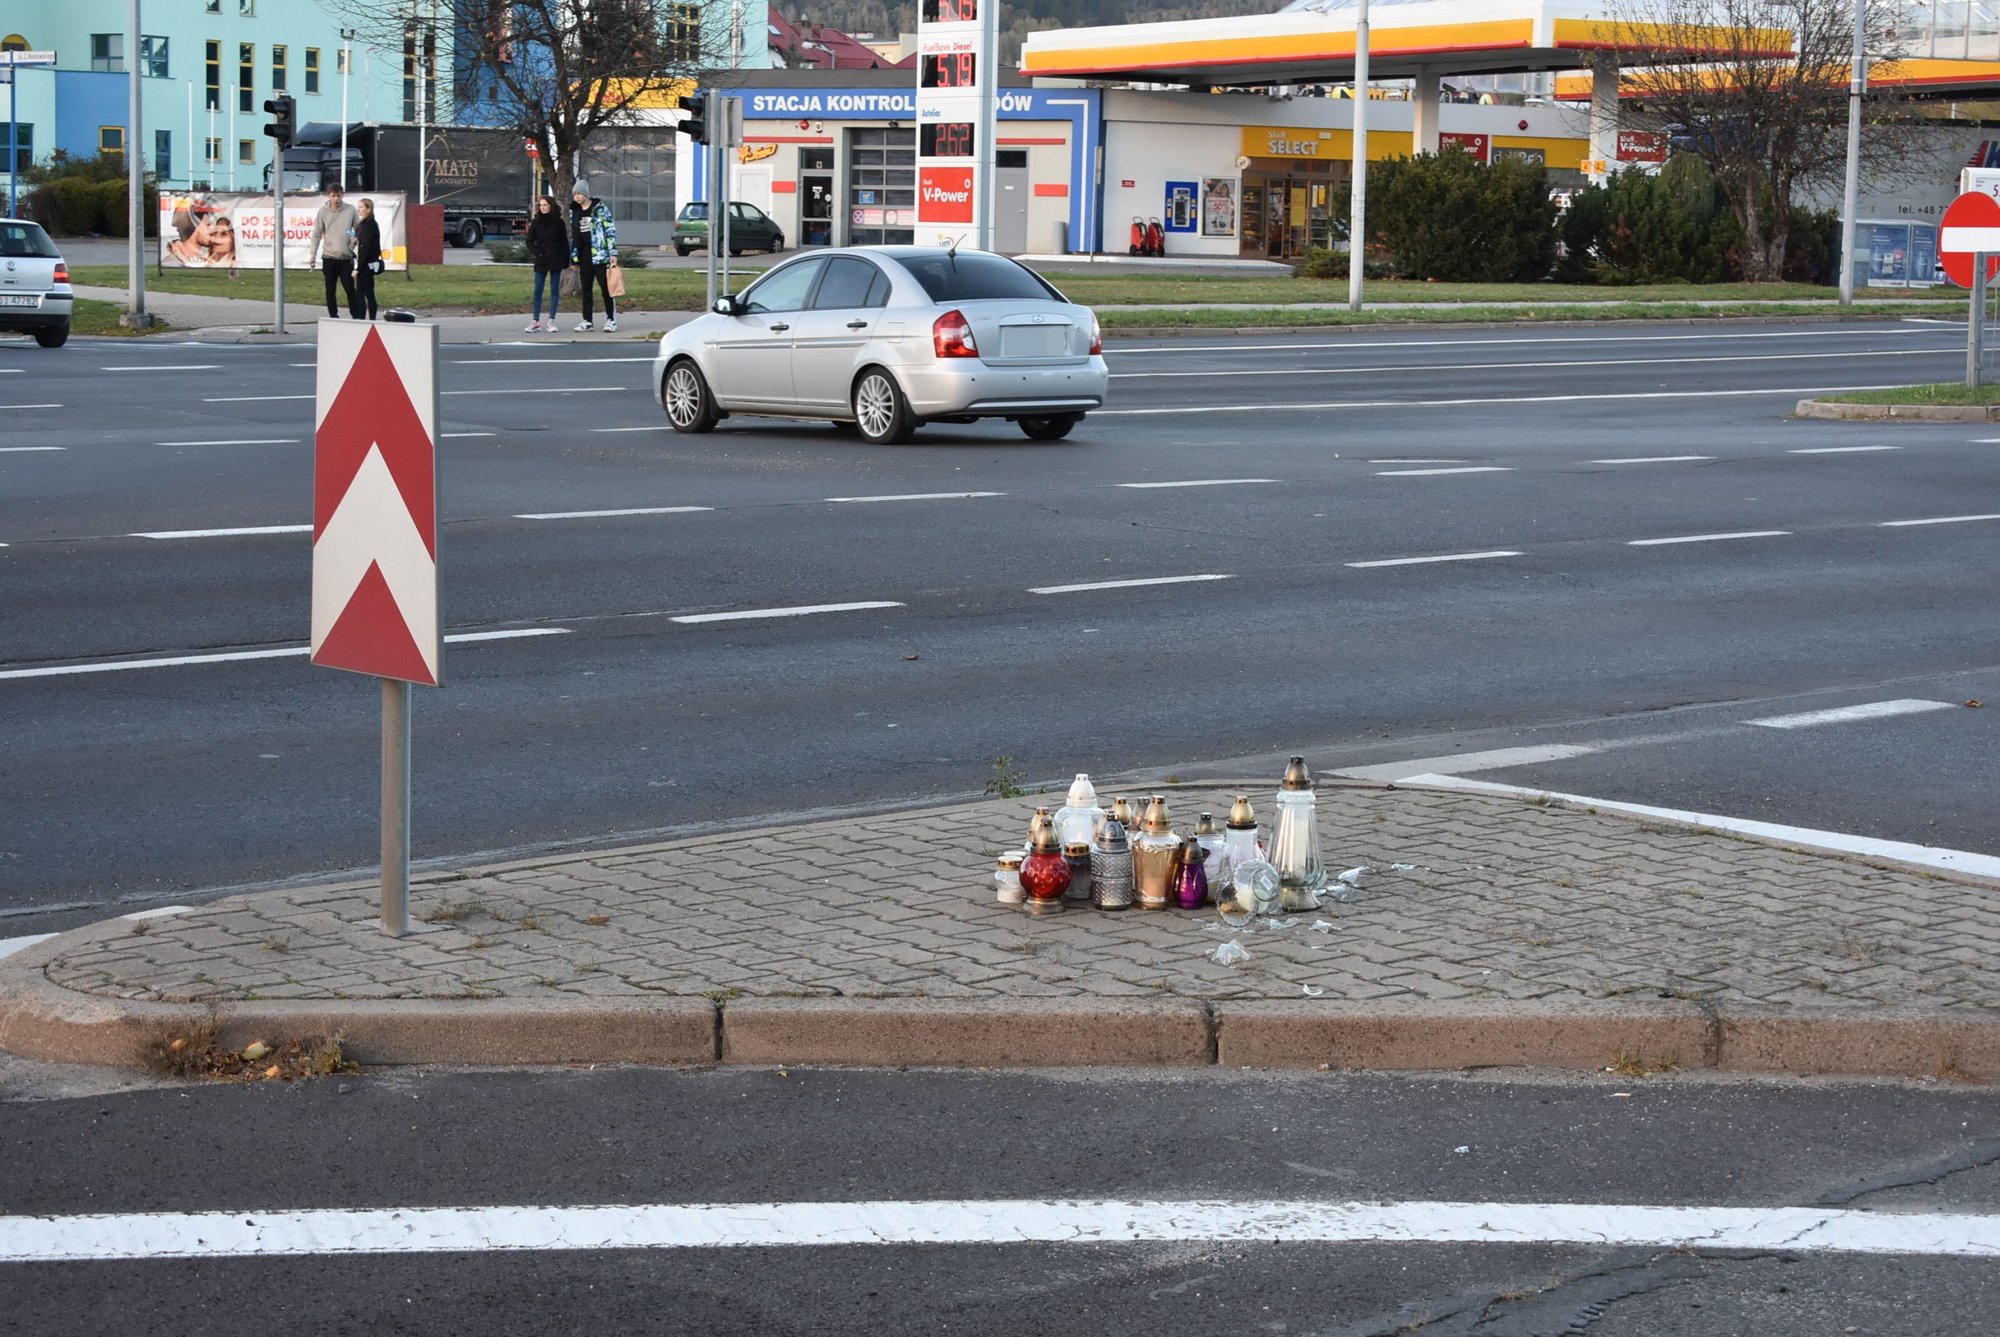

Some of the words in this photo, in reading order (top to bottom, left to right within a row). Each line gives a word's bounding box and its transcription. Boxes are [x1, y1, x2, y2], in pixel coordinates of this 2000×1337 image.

[953, 41, 973, 51] Diesel
[753, 95, 822, 111] STACJA
[827, 95, 916, 111] KONTROL
[1442, 136, 1456, 144] Shell
[1268, 140, 1318, 154] SELECT
[923, 187, 969, 203] V-Power
[1898, 205, 1916, 215] tel.
[1917, 206, 1936, 215] +48
[242, 216, 260, 227] DO
[242, 230, 260, 240] NA
